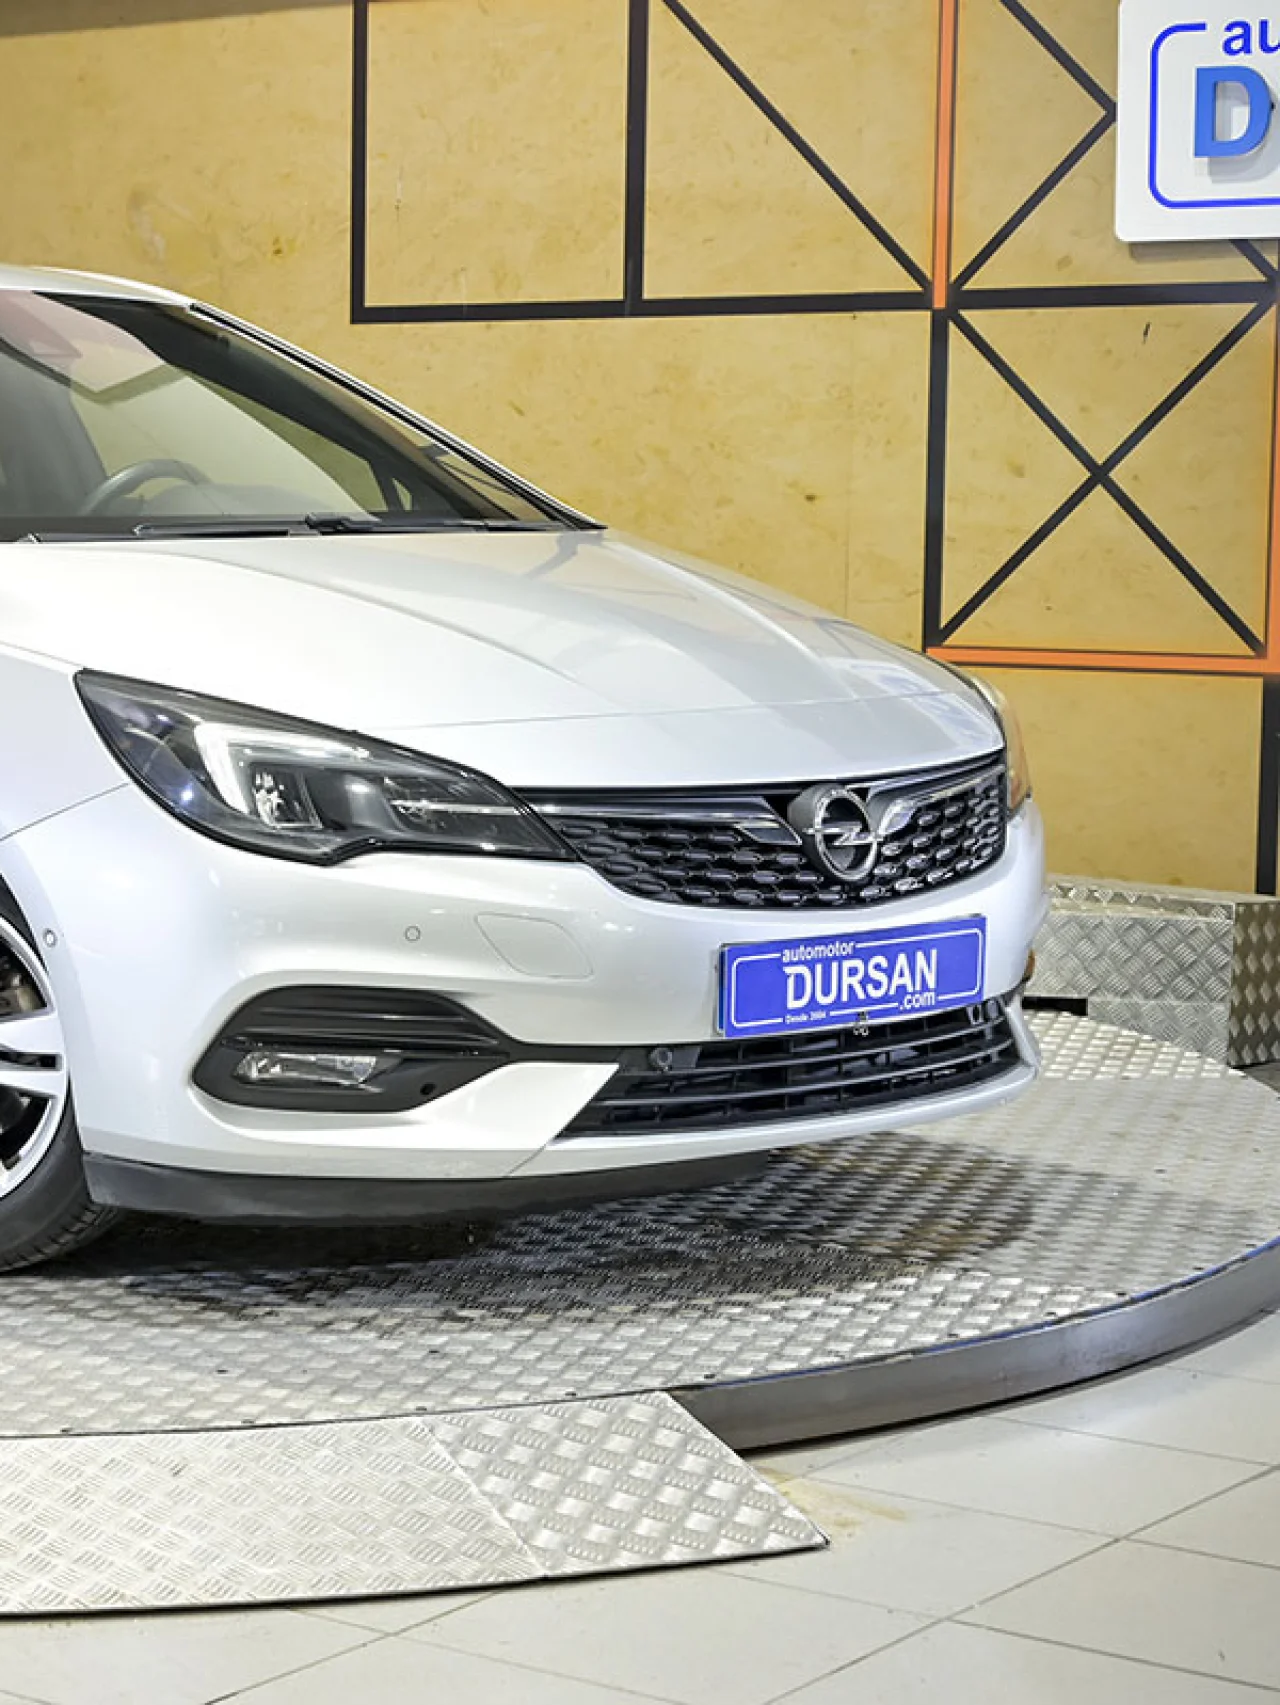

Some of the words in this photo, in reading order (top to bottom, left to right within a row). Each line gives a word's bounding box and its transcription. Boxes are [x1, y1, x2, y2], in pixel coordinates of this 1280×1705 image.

[1194, 66, 1272, 158] D
[783, 941, 856, 962] automotor
[783, 949, 938, 1010] DURSAN
[899, 990, 936, 1011] .com
